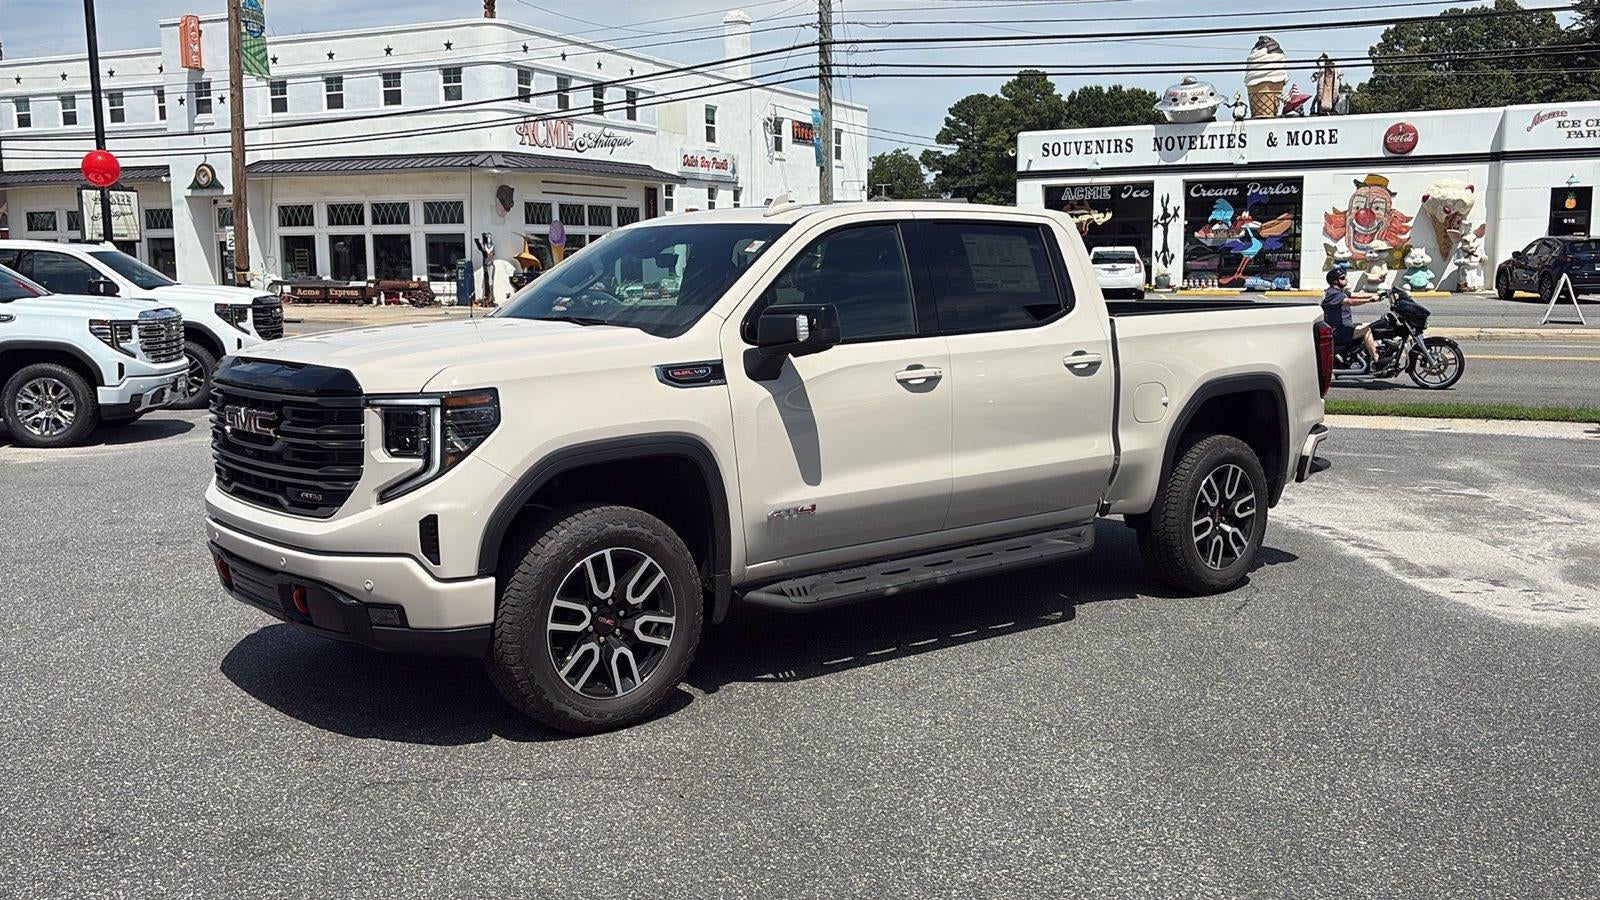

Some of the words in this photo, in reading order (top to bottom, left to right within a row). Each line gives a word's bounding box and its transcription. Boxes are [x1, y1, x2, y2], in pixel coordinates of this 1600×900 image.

[189, 19, 200, 65] ACME
[792, 120, 813, 140] Fires
[1557, 120, 1581, 128] ICE
[515, 116, 575, 151] ACME
[574, 126, 634, 155] Antiques
[1041, 138, 1134, 157] SOUVENIRS
[1152, 132, 1247, 152] NOVELTIES
[1266, 131, 1278, 147] &
[1287, 128, 1338, 147] MORE
[682, 153, 699, 168] Dutch
[700, 156, 711, 171] Boy
[712, 157, 729, 171] Paints
[1061, 186, 1112, 201] ACME
[1121, 184, 1150, 199] Ice
[1190, 182, 1239, 198] Cream
[1247, 178, 1300, 197] Parlor
[296, 288, 320, 296] Acme
[329, 287, 359, 297] Express
[224, 405, 278, 436] GMC
[767, 503, 816, 520] AT4
